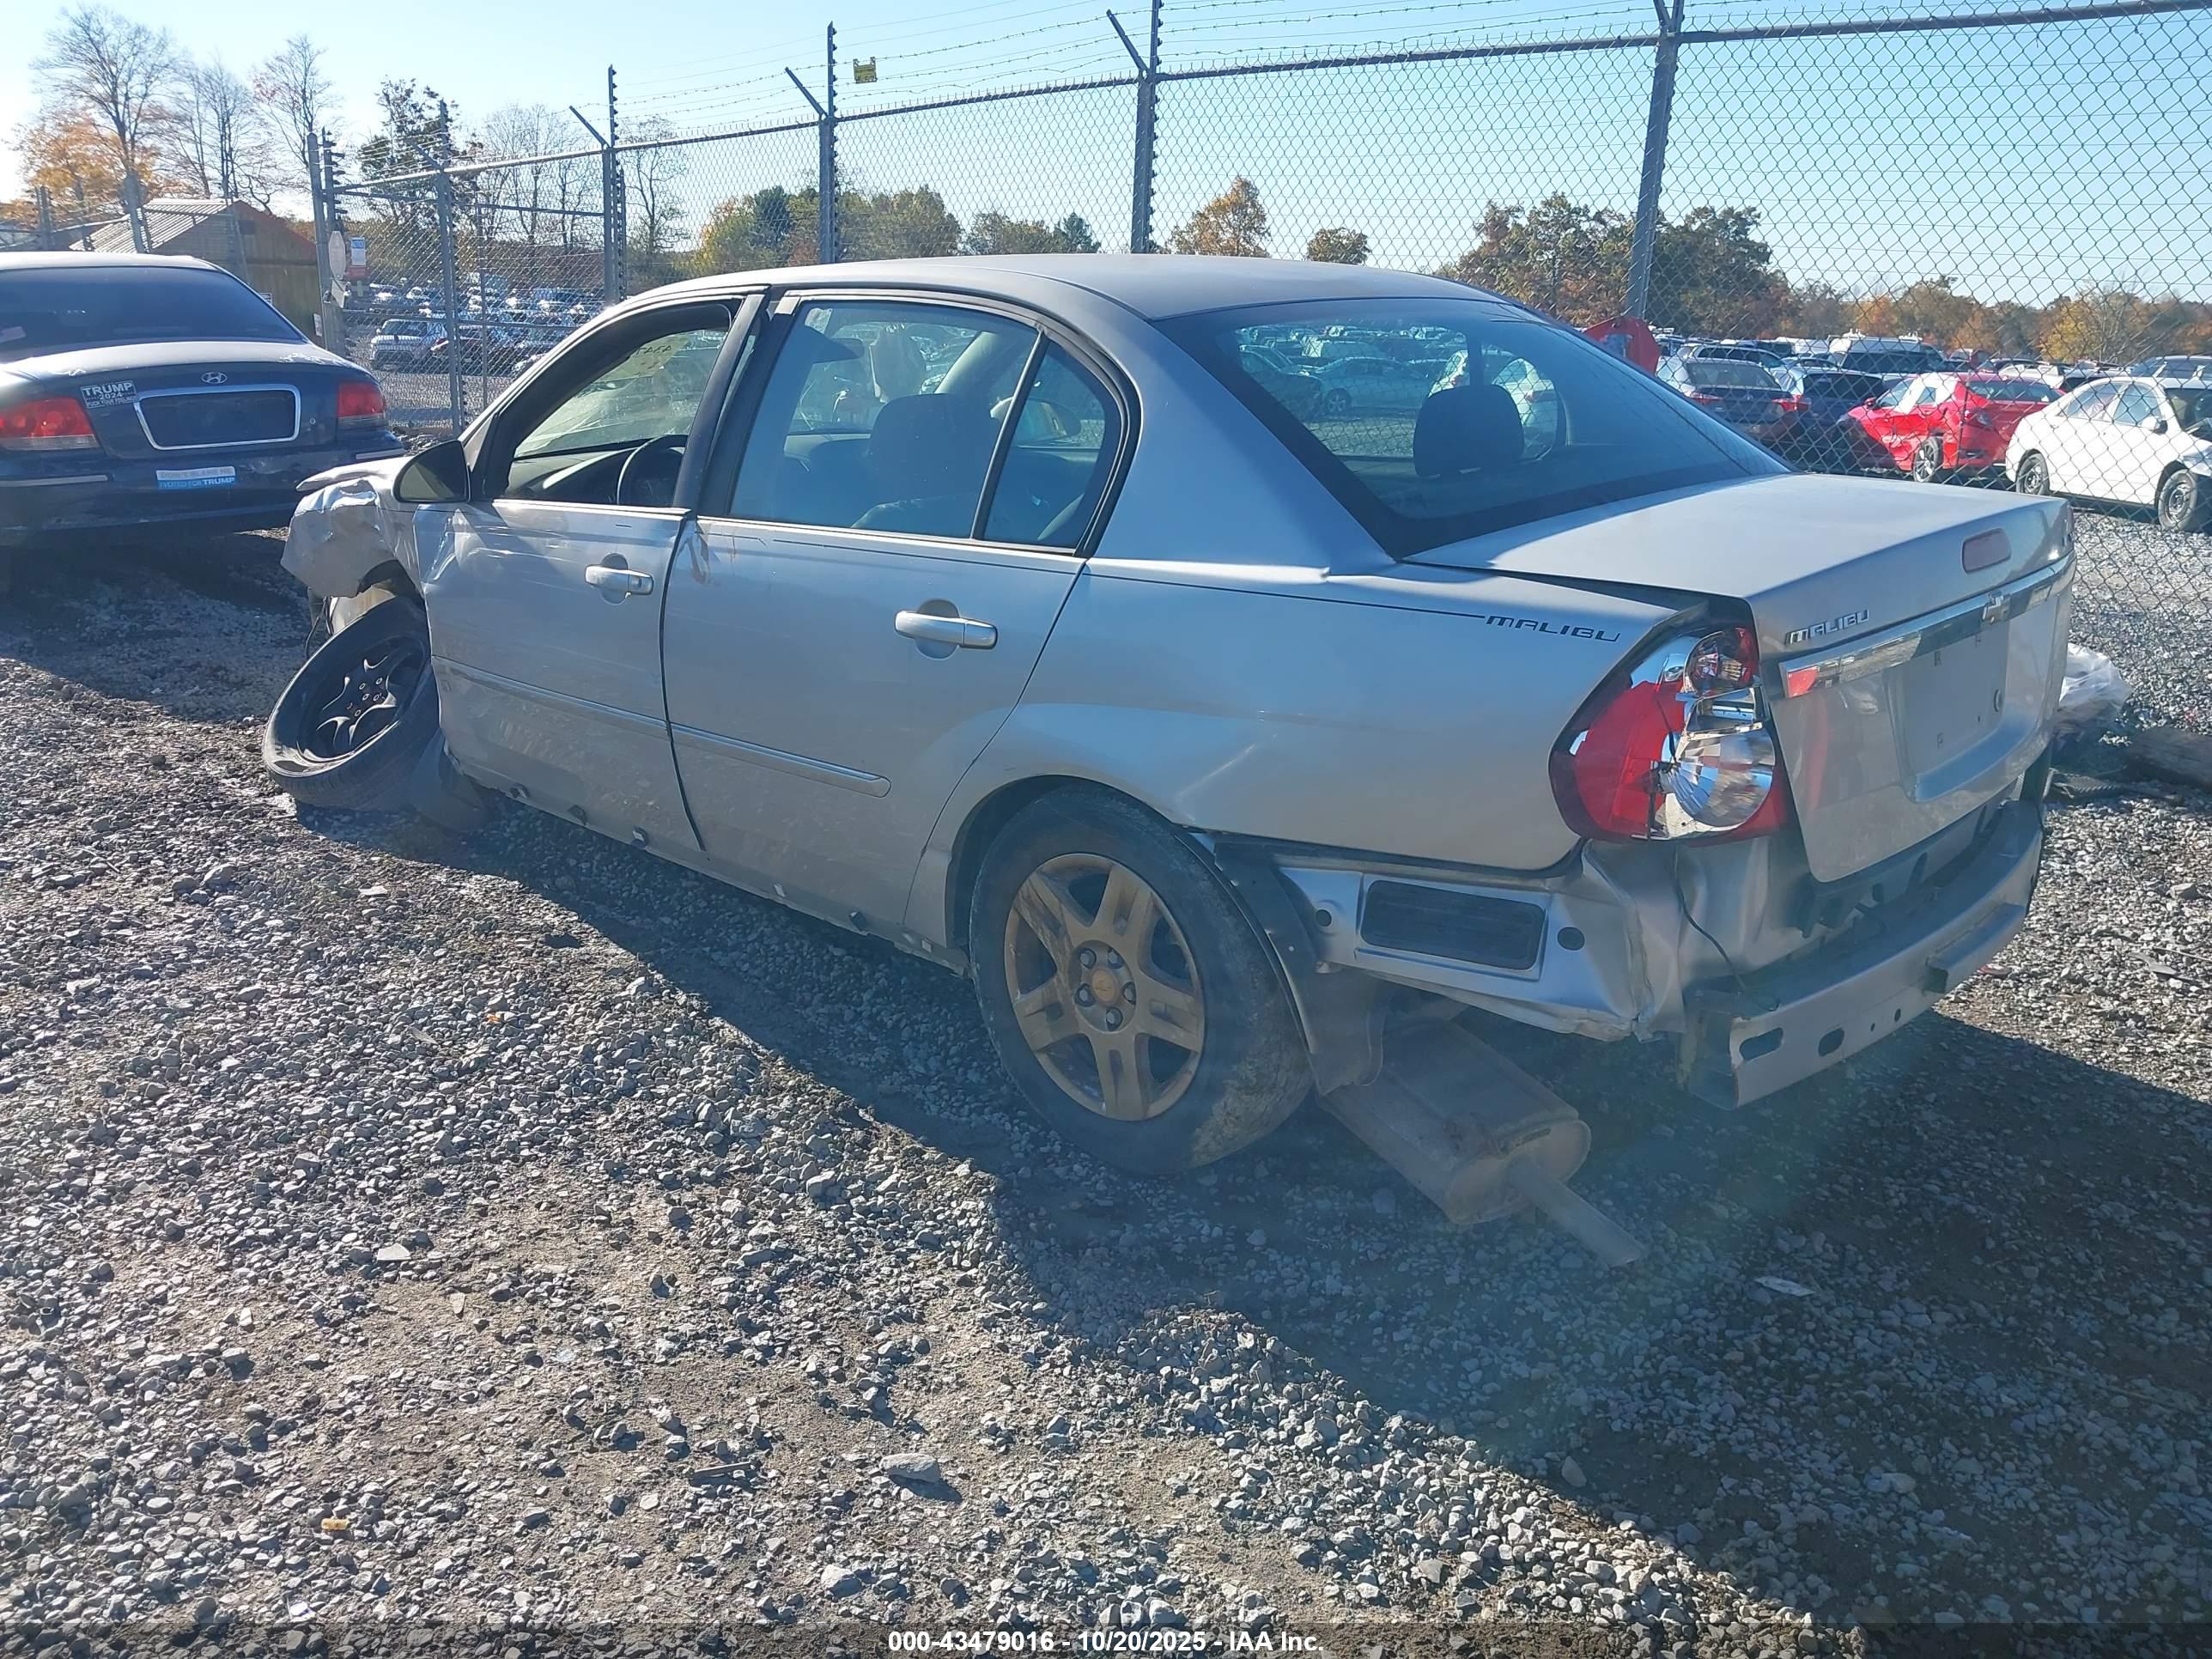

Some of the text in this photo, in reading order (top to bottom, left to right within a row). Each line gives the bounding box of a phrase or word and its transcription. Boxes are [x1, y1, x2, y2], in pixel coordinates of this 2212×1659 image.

[82, 382, 133, 396] TRUMP
[99, 392, 123, 400] 2024
[203, 477, 234, 486] TRUMP
[1486, 616, 1621, 642] MALIBU
[1784, 609, 1869, 646] MALIBU
